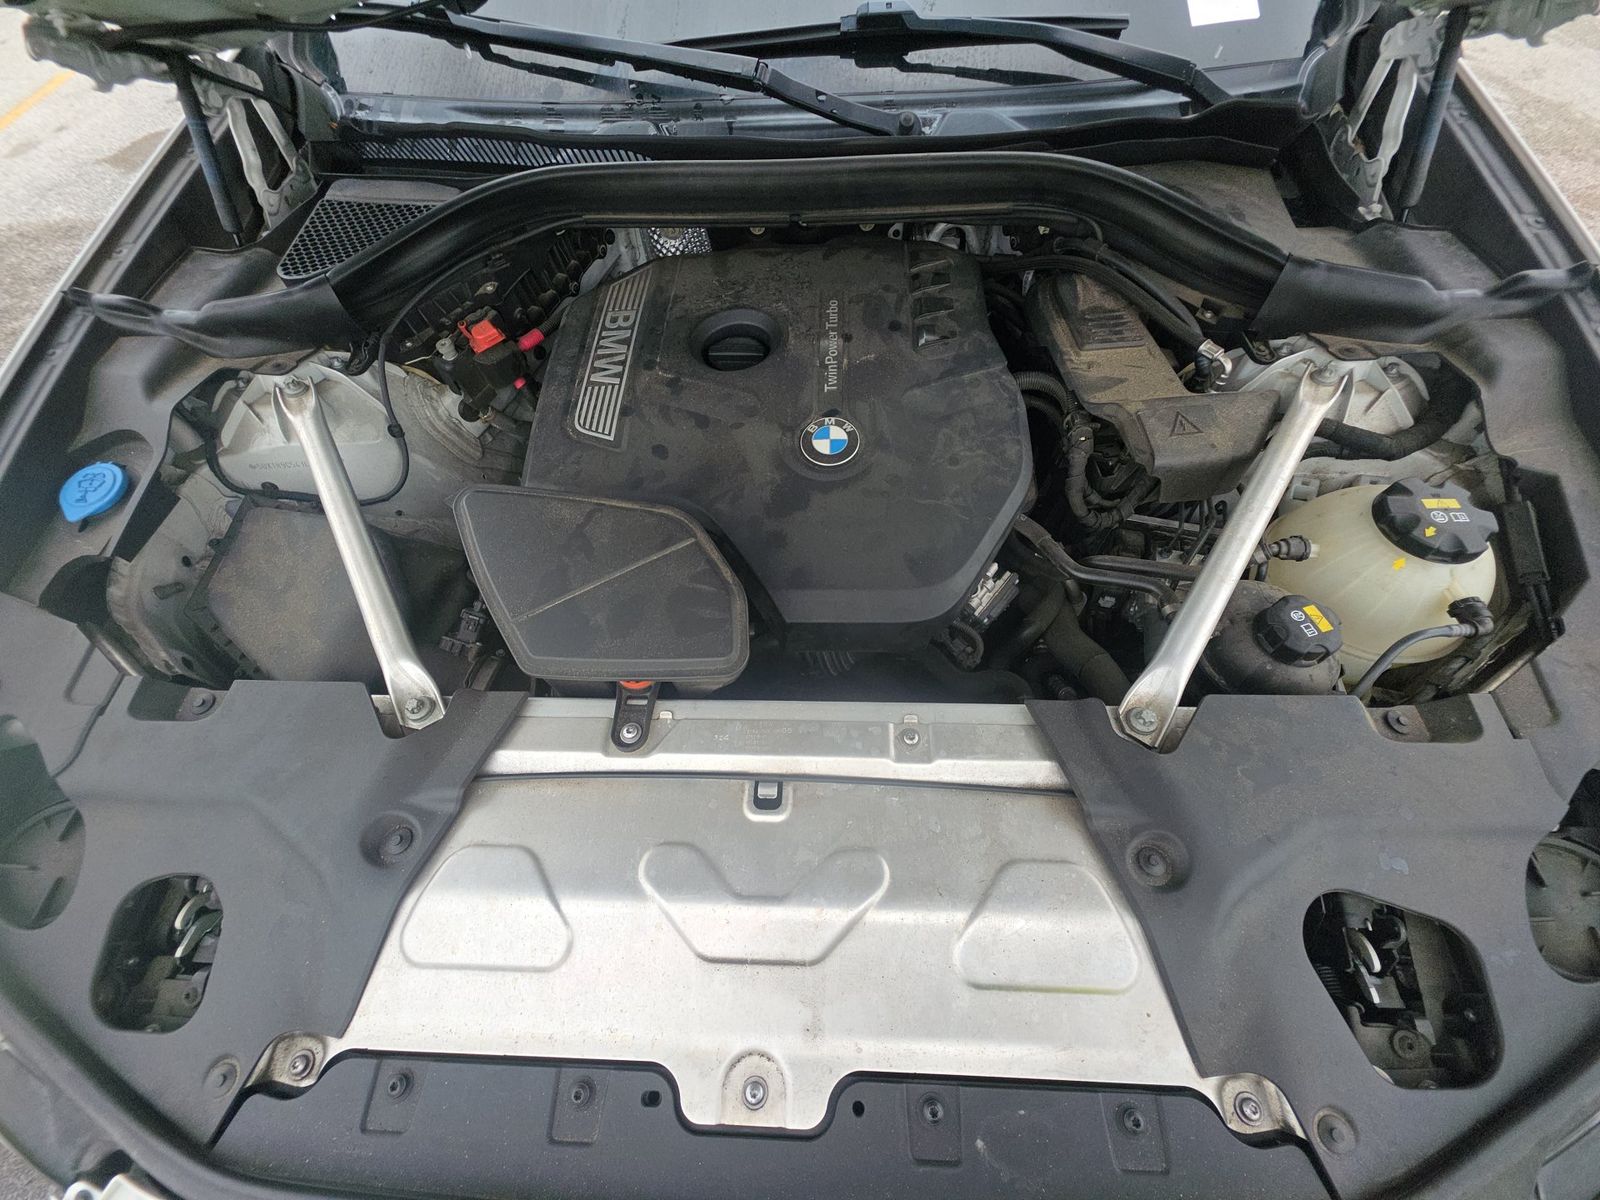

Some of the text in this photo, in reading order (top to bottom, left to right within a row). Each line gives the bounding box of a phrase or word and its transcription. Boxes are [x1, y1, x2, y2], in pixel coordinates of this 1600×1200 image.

[590, 310, 636, 384] BMW
[824, 300, 838, 392] TwinPower Turbo
[807, 417, 854, 433] BMW
